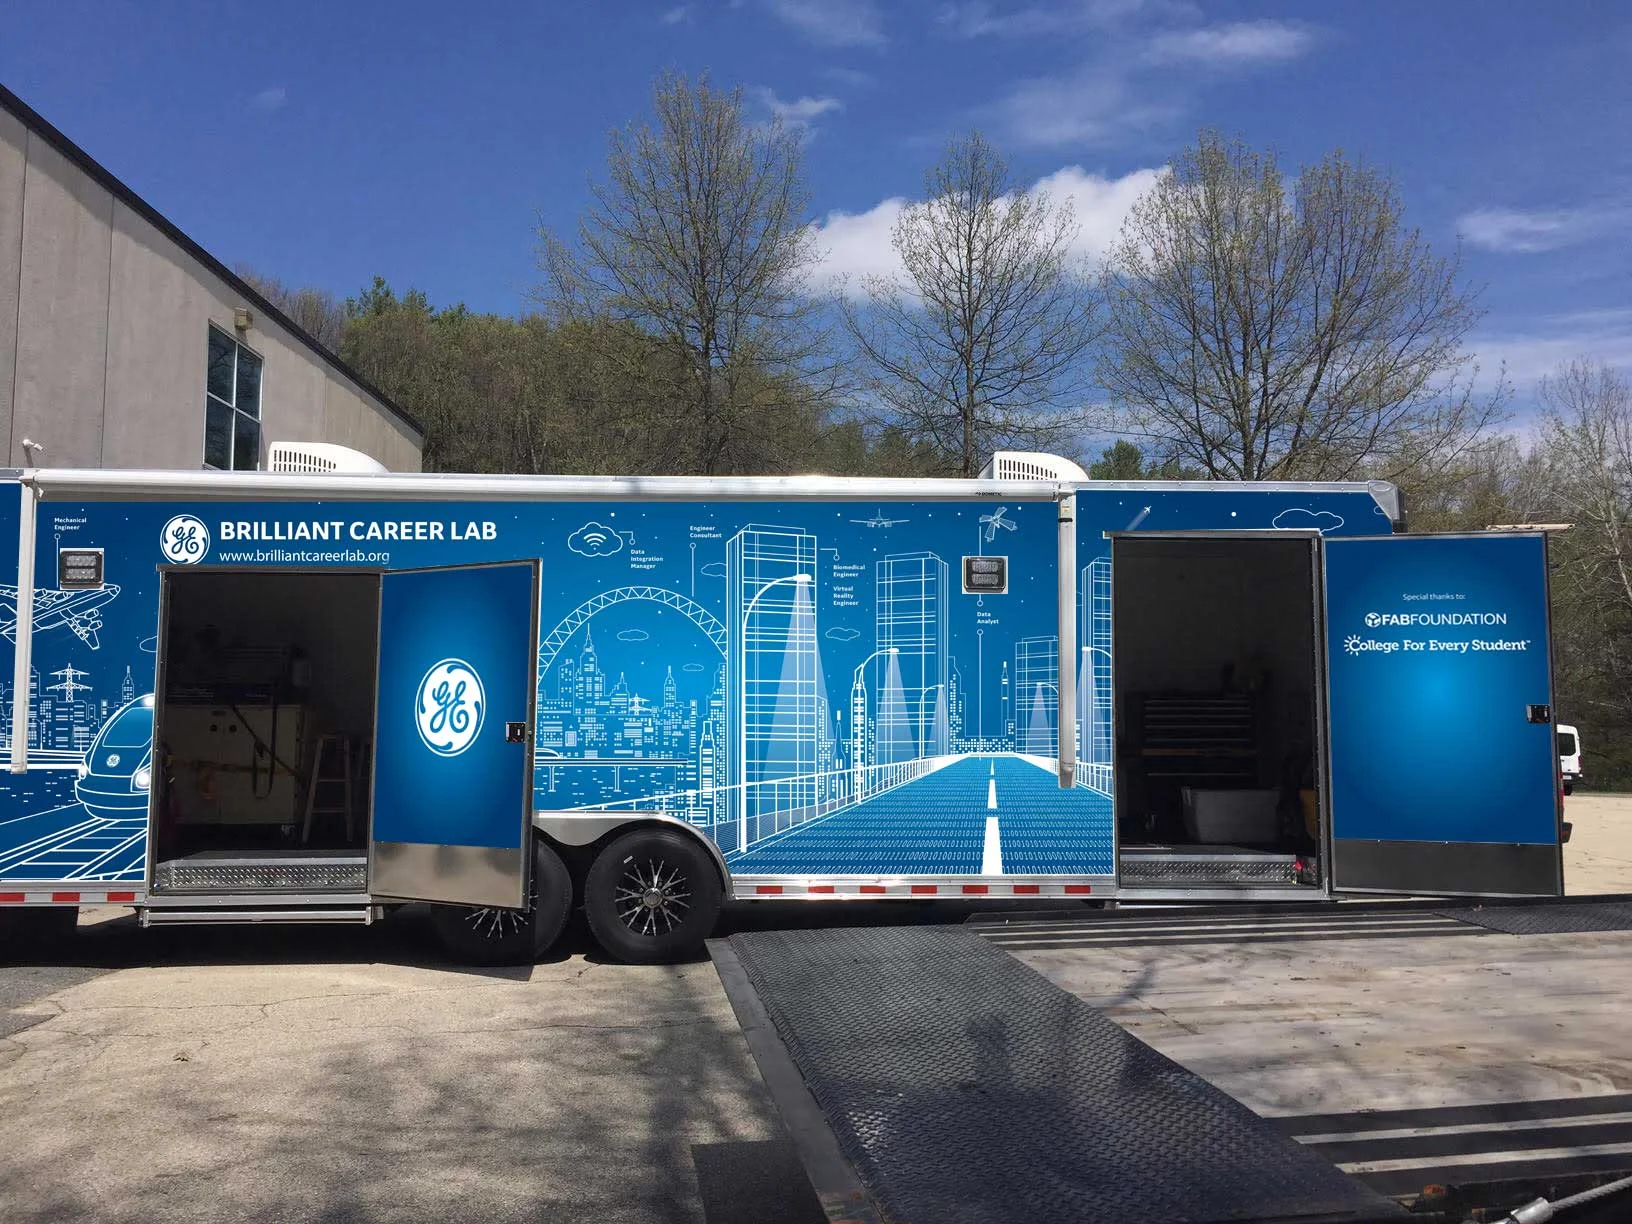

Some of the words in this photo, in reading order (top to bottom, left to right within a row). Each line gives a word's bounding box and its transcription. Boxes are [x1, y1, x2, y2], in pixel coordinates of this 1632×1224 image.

[220, 521, 345, 541] BRILLIANT
[349, 521, 445, 541] CAREER
[451, 521, 497, 541] LAB
[219, 549, 390, 565] www.brilliantcareerlab.org
[1402, 593, 1429, 601] Special
[1382, 613, 1507, 626] FABFOUNDATION
[1349, 639, 1400, 653] College
[1403, 639, 1426, 651] For
[1429, 639, 1469, 654] Every
